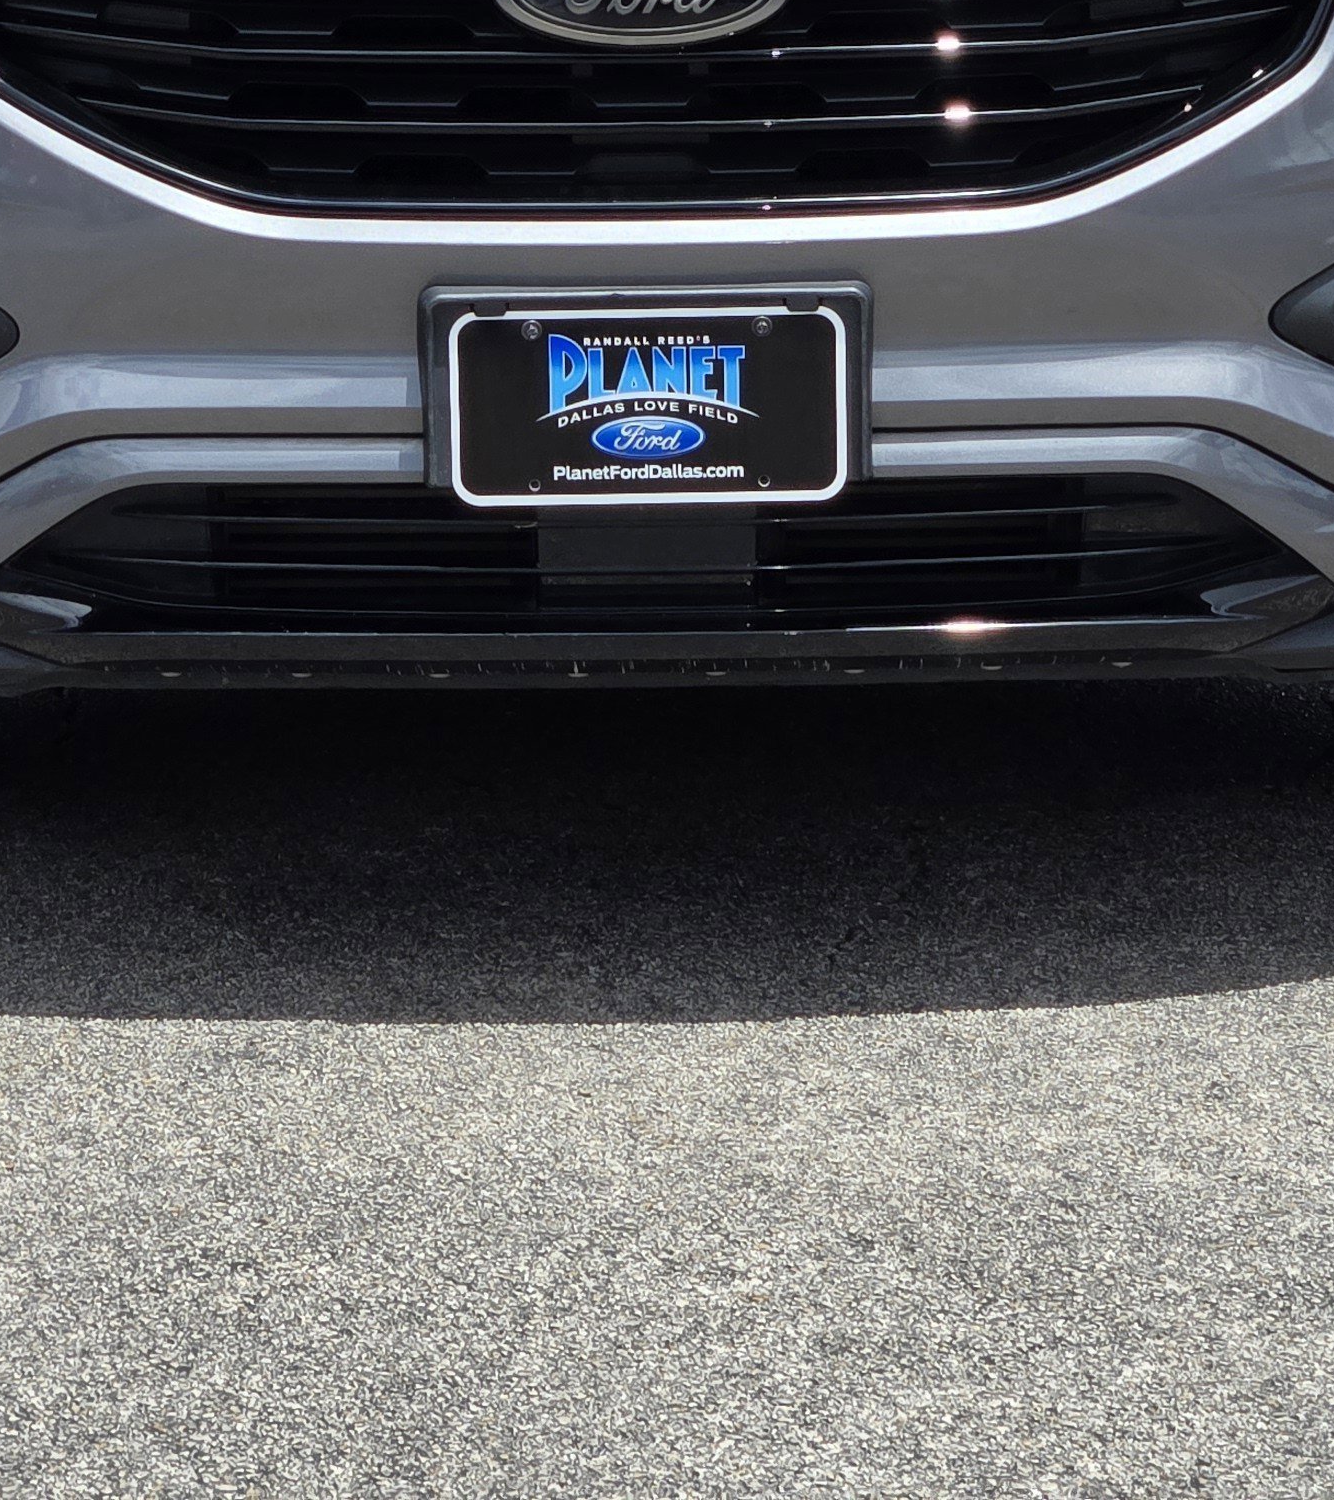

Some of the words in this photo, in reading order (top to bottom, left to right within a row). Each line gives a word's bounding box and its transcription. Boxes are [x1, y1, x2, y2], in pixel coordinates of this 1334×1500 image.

[583, 336, 650, 346] RANDALL
[657, 335, 711, 346] REED'S
[548, 333, 746, 414] PLANET
[557, 402, 625, 429] DALLAS
[633, 400, 680, 412] LOVE
[688, 403, 739, 425] FIELD
[613, 422, 683, 451] Ford
[553, 463, 745, 481] PlanetFordDallas.com
